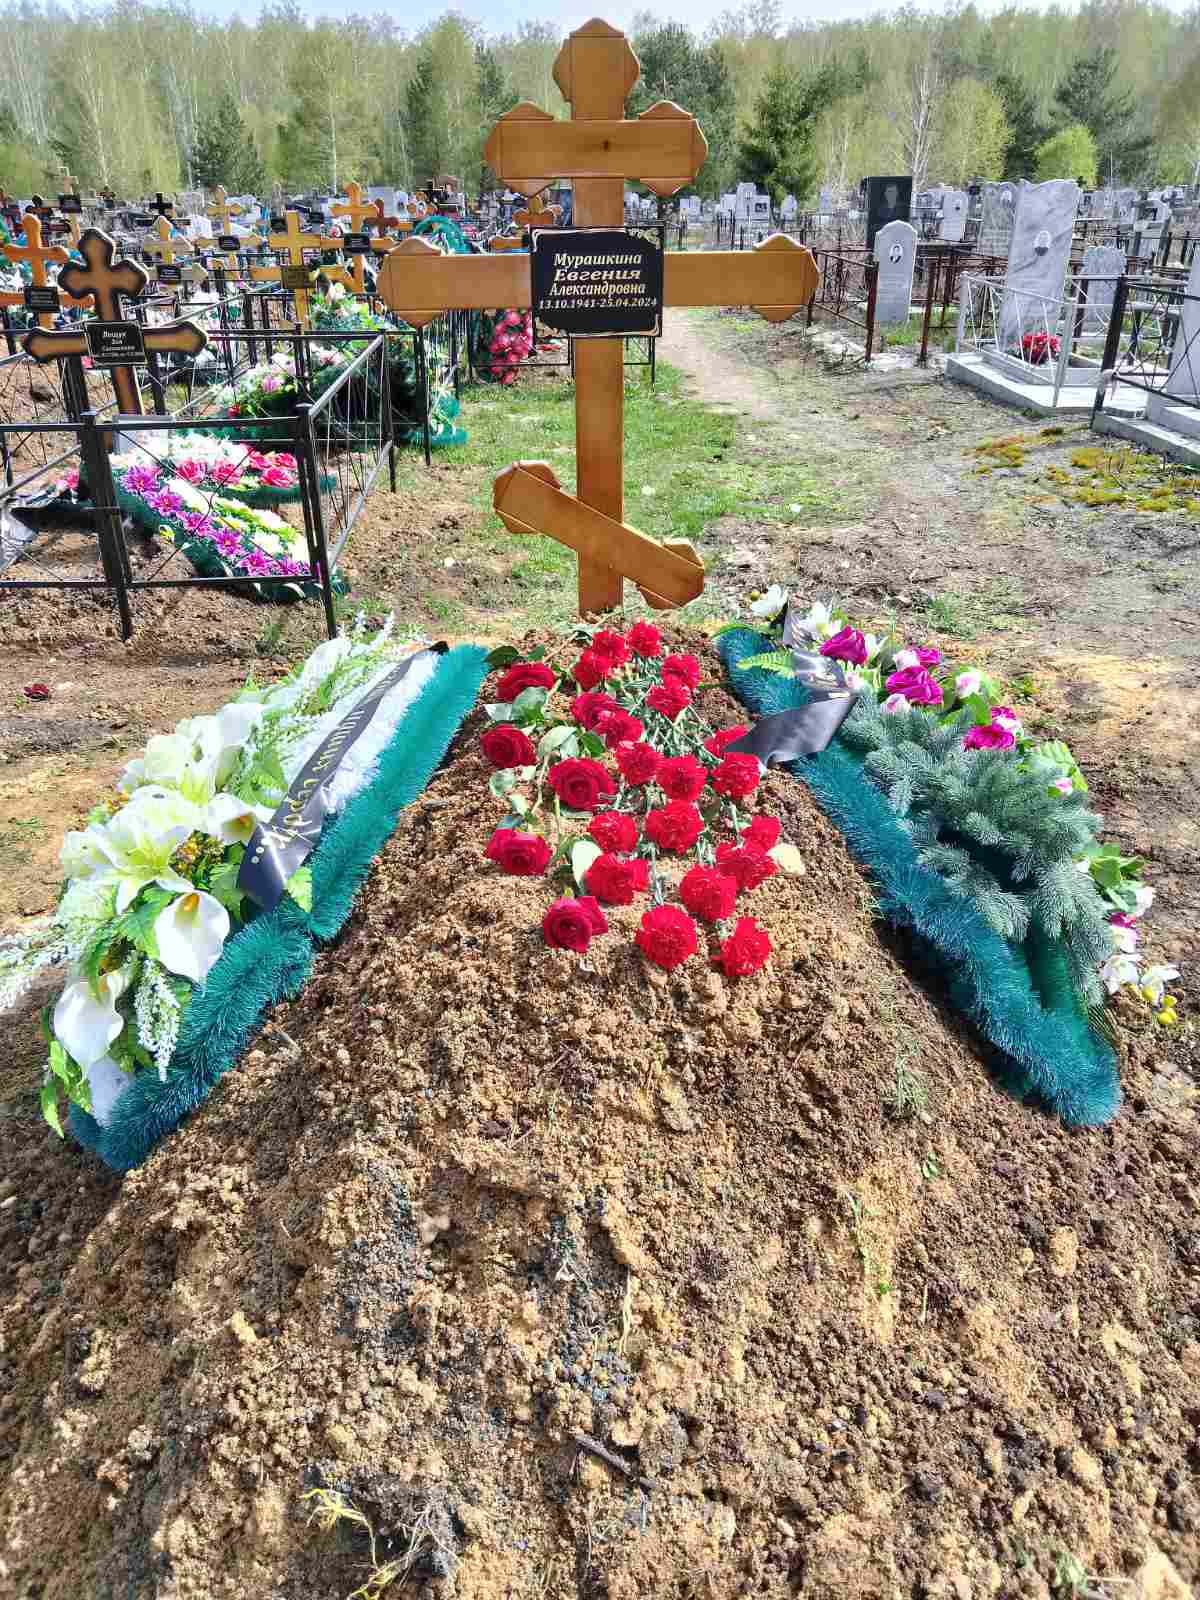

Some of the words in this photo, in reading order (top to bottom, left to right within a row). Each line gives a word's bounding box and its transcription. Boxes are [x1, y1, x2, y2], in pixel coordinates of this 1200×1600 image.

[553, 252, 642, 269] Мурашкина
[554, 268, 641, 281] Евгения
[549, 281, 645, 298] Александровна
[539, 298, 657, 309] 13.10.1941-25.04.2024
